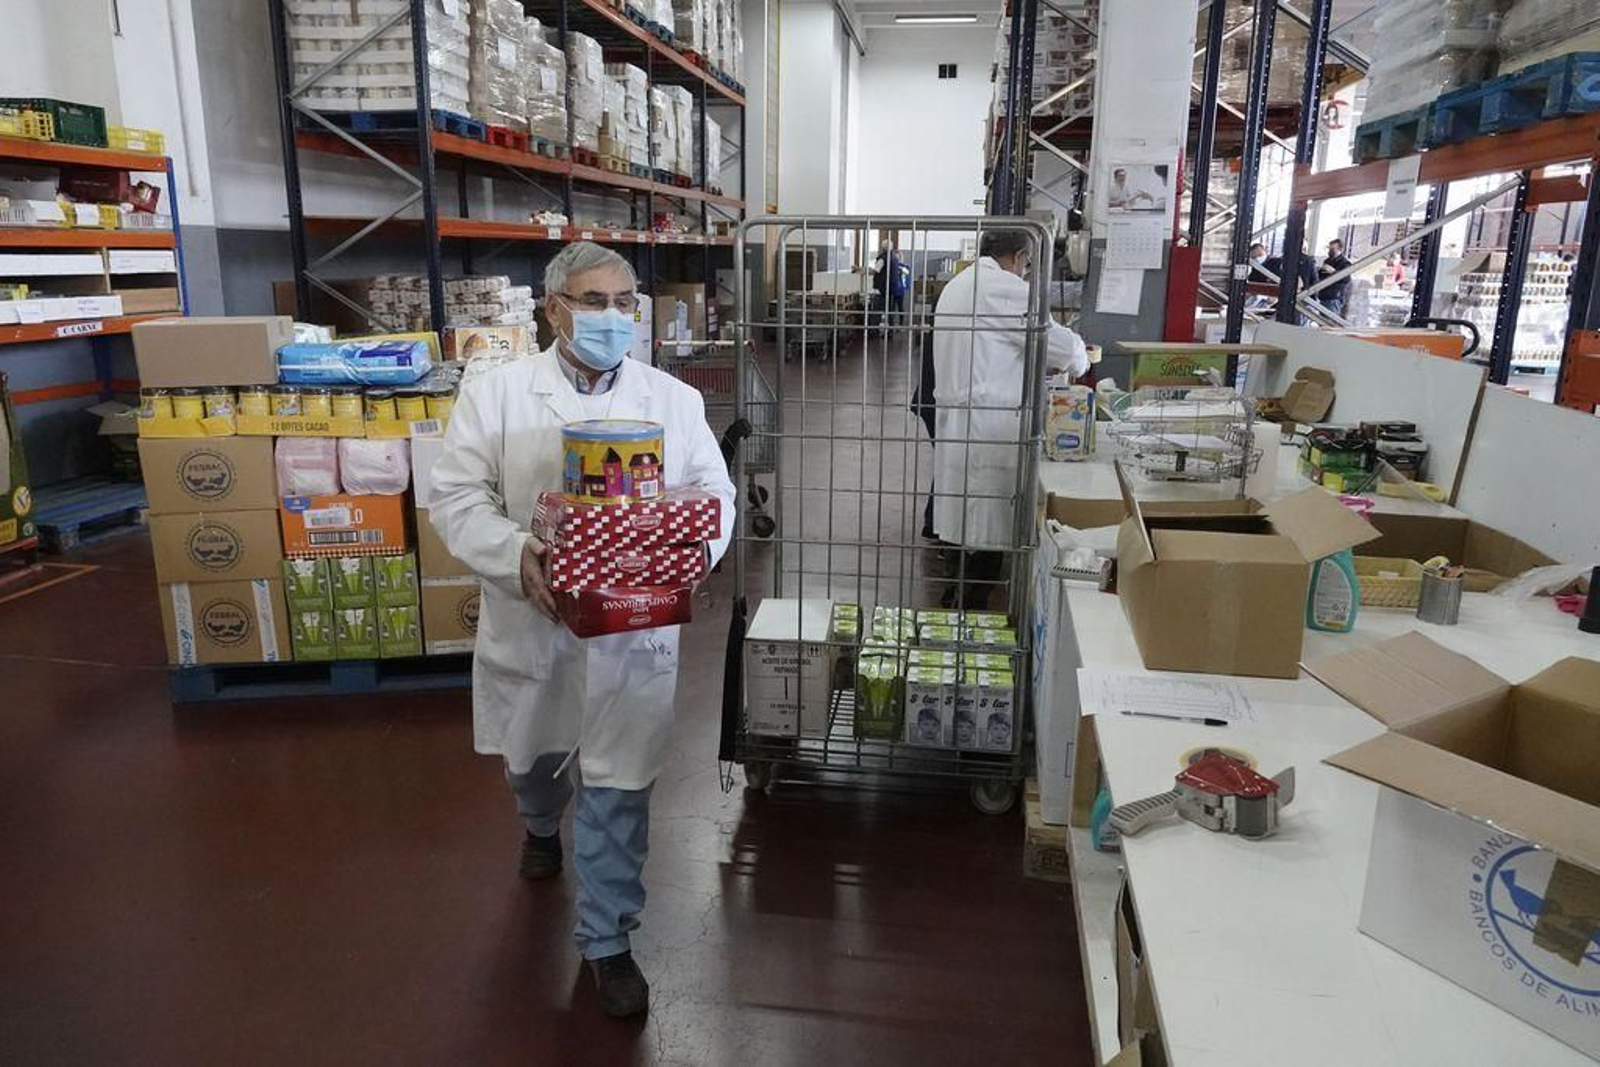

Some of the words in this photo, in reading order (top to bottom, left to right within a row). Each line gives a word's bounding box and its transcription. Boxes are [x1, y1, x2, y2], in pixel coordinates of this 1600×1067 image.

[305, 422, 329, 431] CACAO
[1468, 889, 1517, 971] BANCOS
[1520, 971, 1550, 998] DE
